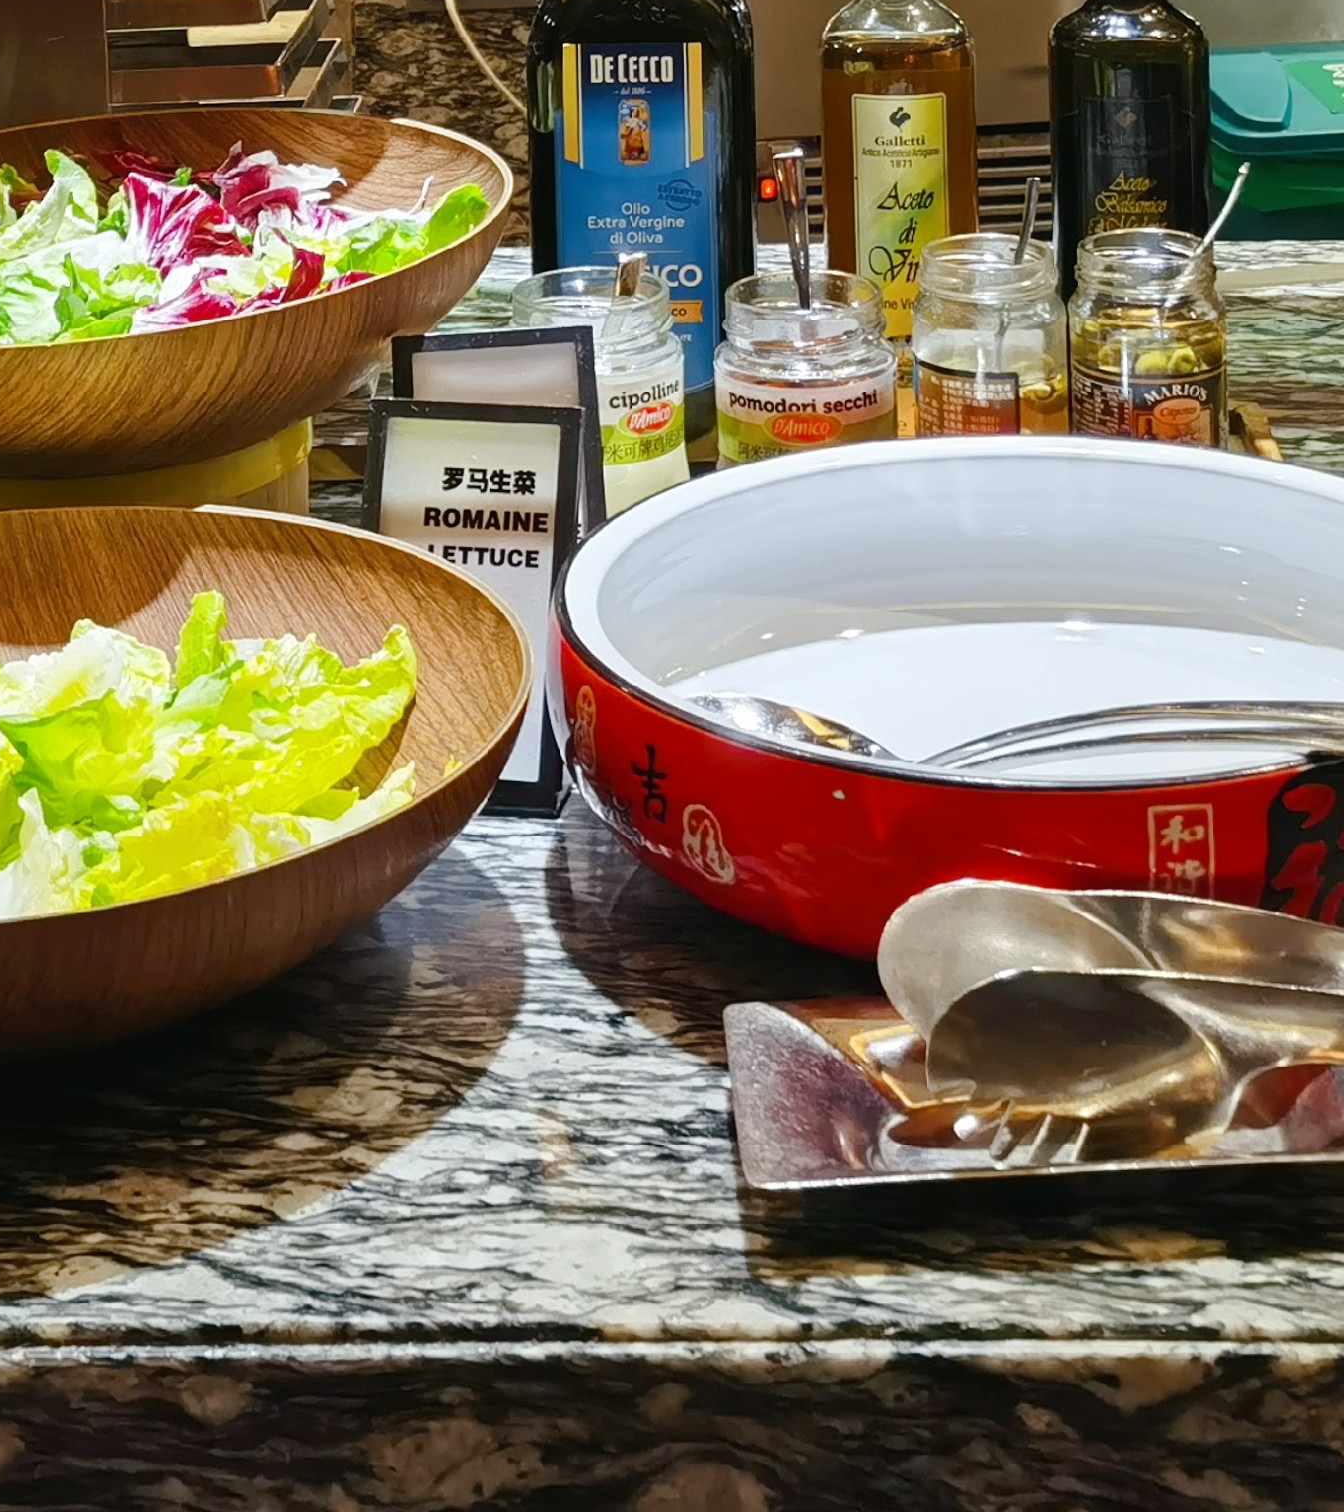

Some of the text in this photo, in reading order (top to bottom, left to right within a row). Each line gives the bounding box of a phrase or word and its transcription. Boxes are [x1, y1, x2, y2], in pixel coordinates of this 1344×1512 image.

[617, 53, 674, 83] CECCO
[874, 135, 926, 146] Galletti
[890, 160, 913, 169] 1871
[877, 181, 935, 210] Aceto
[621, 202, 650, 215] Olio
[587, 216, 685, 230] Extra Vergine
[898, 217, 918, 244] di
[610, 232, 664, 244] di Oliva
[609, 380, 679, 409] cipolline
[729, 390, 878, 414] pomodori secchi
[630, 406, 671, 429] D'Amico
[774, 419, 830, 436] D'Amico
[442, 467, 536, 495] 罗马生菜
[423, 507, 549, 533] ROMAINE
